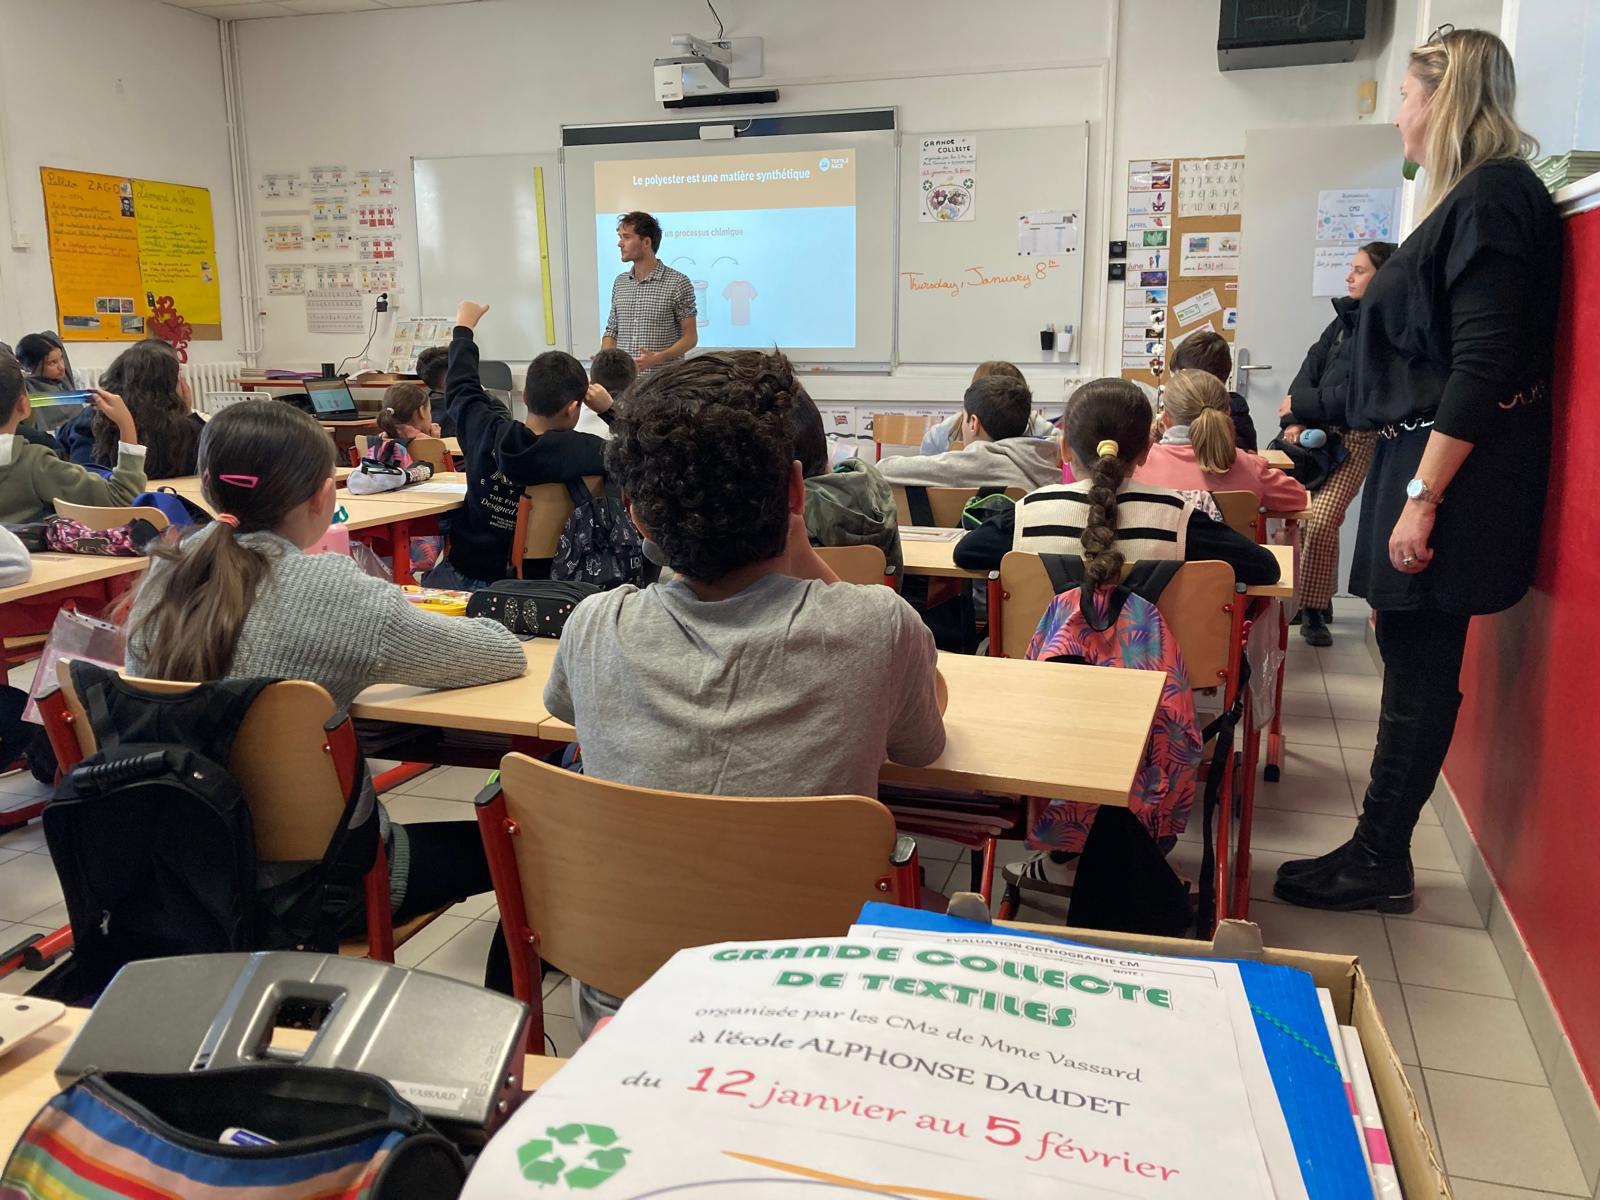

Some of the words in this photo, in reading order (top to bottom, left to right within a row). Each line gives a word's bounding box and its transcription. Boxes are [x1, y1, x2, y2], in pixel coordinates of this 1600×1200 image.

[923, 139, 955, 147] GRANDE
[937, 145, 971, 154] COLLECTE
[632, 175, 643, 186] Le
[644, 175, 685, 187] polyester
[687, 173, 701, 184] est
[702, 174, 718, 183] une
[720, 171, 755, 182] matière
[756, 168, 811, 183] synthétique
[664, 229, 674, 238] un
[674, 229, 710, 239] processus
[710, 227, 744, 238] chimique
[1127, 263, 1144, 271] June
[964, 266, 1031, 288] January
[481, 498, 517, 516] Designed
[490, 493, 503, 503] THE
[946, 938, 1022, 949] EVALUATION
[1025, 944, 1116, 965] ORTHOGRAPHE
[1119, 959, 1140, 968] CM
[711, 945, 901, 962] GRANDE
[915, 949, 1173, 1009] COLLECTE
[1113, 969, 1138, 977] NOTE
[774, 970, 847, 989] DE
[860, 974, 1076, 1028] TEXTILES
[694, 1006, 799, 1019] organisée
[802, 1010, 846, 1022] par
[850, 1009, 879, 1026] les
[886, 1015, 939, 1037] CM2
[946, 1024, 974, 1044] de
[981, 1034, 1041, 1061] Mme
[1044, 1050, 1144, 1083] Vassard
[689, 1030, 706, 1045] à
[714, 1029, 794, 1049] l'école
[798, 1037, 976, 1086] ALPHONSE
[984, 1072, 1131, 1117] DAUDET
[621, 1070, 663, 1089] du
[687, 1066, 756, 1097] 12
[749, 1081, 908, 1122] janvier
[915, 1113, 970, 1138] au
[984, 1115, 1022, 1147] 5
[1024, 1131, 1180, 1182] février
